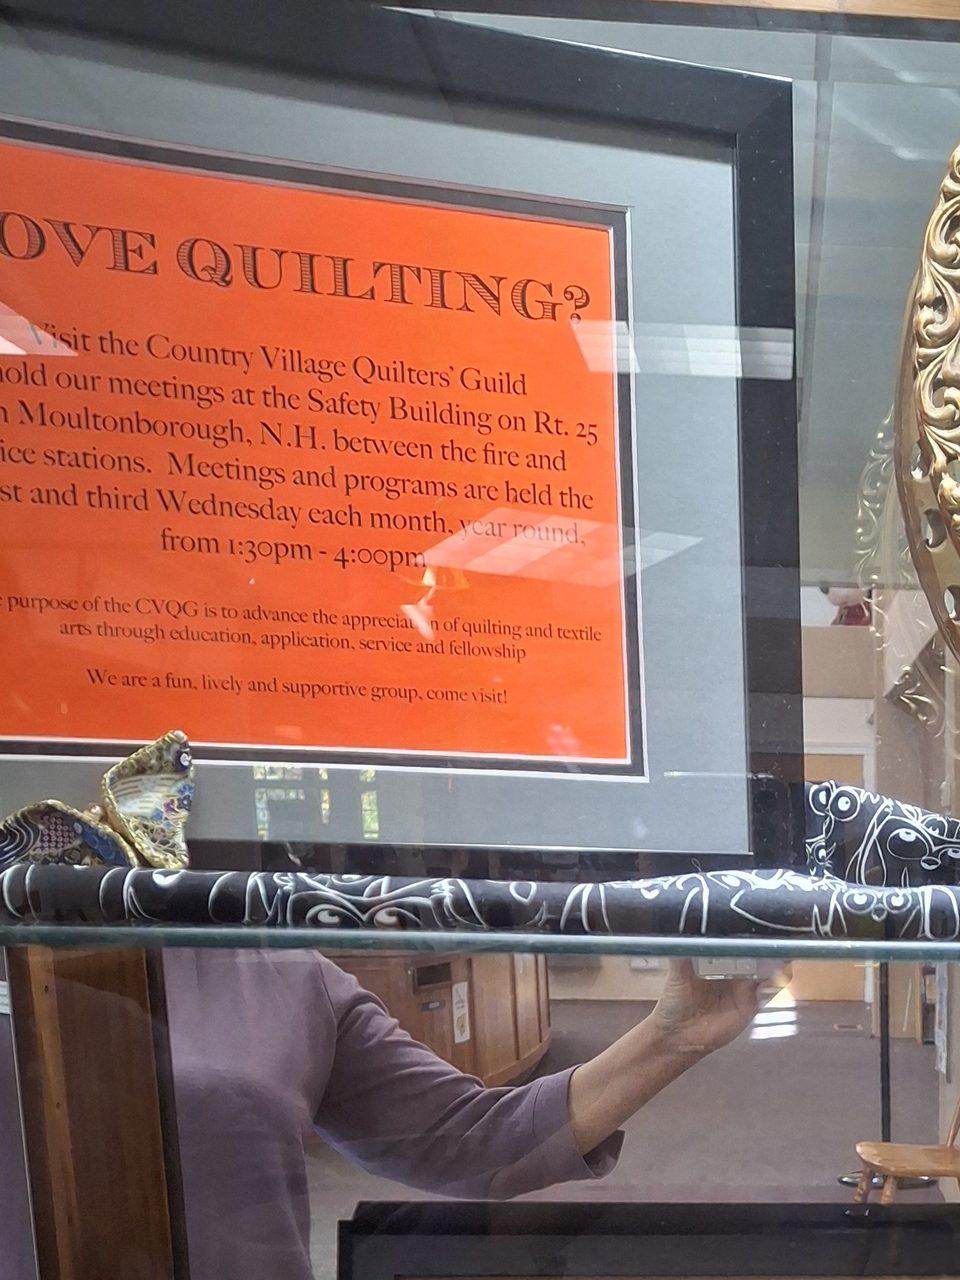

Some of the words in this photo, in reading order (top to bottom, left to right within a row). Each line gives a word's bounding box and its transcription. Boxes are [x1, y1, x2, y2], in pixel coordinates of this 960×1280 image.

[177, 238, 590, 324] QUILTING?
[99, 331, 139, 356] the
[147, 334, 252, 374] Country
[260, 345, 346, 383] Village
[352, 355, 454, 387] Quilters'
[460, 367, 527, 395] Guild
[18, 400, 251, 448] Moultonborough,
[260, 421, 326, 450] N.H.
[334, 429, 433, 460] between
[440, 440, 476, 462] the
[484, 443, 519, 466] fire
[526, 450, 567, 471] and
[56, 371, 101, 392] our
[109, 376, 224, 409] meetings
[232, 386, 254, 406] at
[263, 385, 300, 410] the
[308, 388, 380, 423] Safety
[388, 396, 491, 435] Building
[498, 413, 526, 431] on
[534, 411, 568, 436] Rt.
[576, 423, 597, 445] 25
[43, 447, 152, 473] stations.
[168, 452, 285, 489] Meetings
[292, 466, 336, 488] and
[344, 473, 457, 500] programs
[464, 482, 498, 500] are
[505, 481, 551, 506] held
[559, 487, 594, 509] the
[30, 484, 78, 507] and
[86, 486, 149, 511] third
[157, 488, 300, 529] Wednesday
[308, 504, 362, 527] each
[370, 510, 454, 535] month,
[459, 518, 506, 541] year
[161, 527, 220, 554] from
[228, 538, 312, 565] 1:30pm
[334, 547, 425, 572] 4:00pm
[7, 596, 79, 614] purpose
[83, 596, 101, 612] of
[104, 597, 130, 613] the
[136, 598, 199, 619] CVQG
[204, 603, 217, 617] is
[222, 605, 238, 619] to
[243, 606, 308, 623] advance
[313, 608, 337, 624] the
[342, 612, 439, 632] appreciatn
[443, 617, 461, 632] of
[462, 619, 521, 640] quilting
[525, 624, 552, 638] and
[557, 625, 601, 641] textile
[60, 623, 92, 635] arts
[96, 622, 165, 643] through
[170, 626, 256, 645] education,
[261, 632, 354, 650] application,
[359, 636, 412, 652] service
[416, 641, 444, 654] and
[449, 642, 526, 662] fellowship
[87, 669, 117, 686] We
[121, 674, 147, 686] are
[152, 675, 161, 687] a
[203, 674, 242, 694] lively
[248, 678, 278, 693] and
[281, 682, 366, 698] supportive
[427, 688, 468, 701] come
[471, 688, 507, 704] visit!
